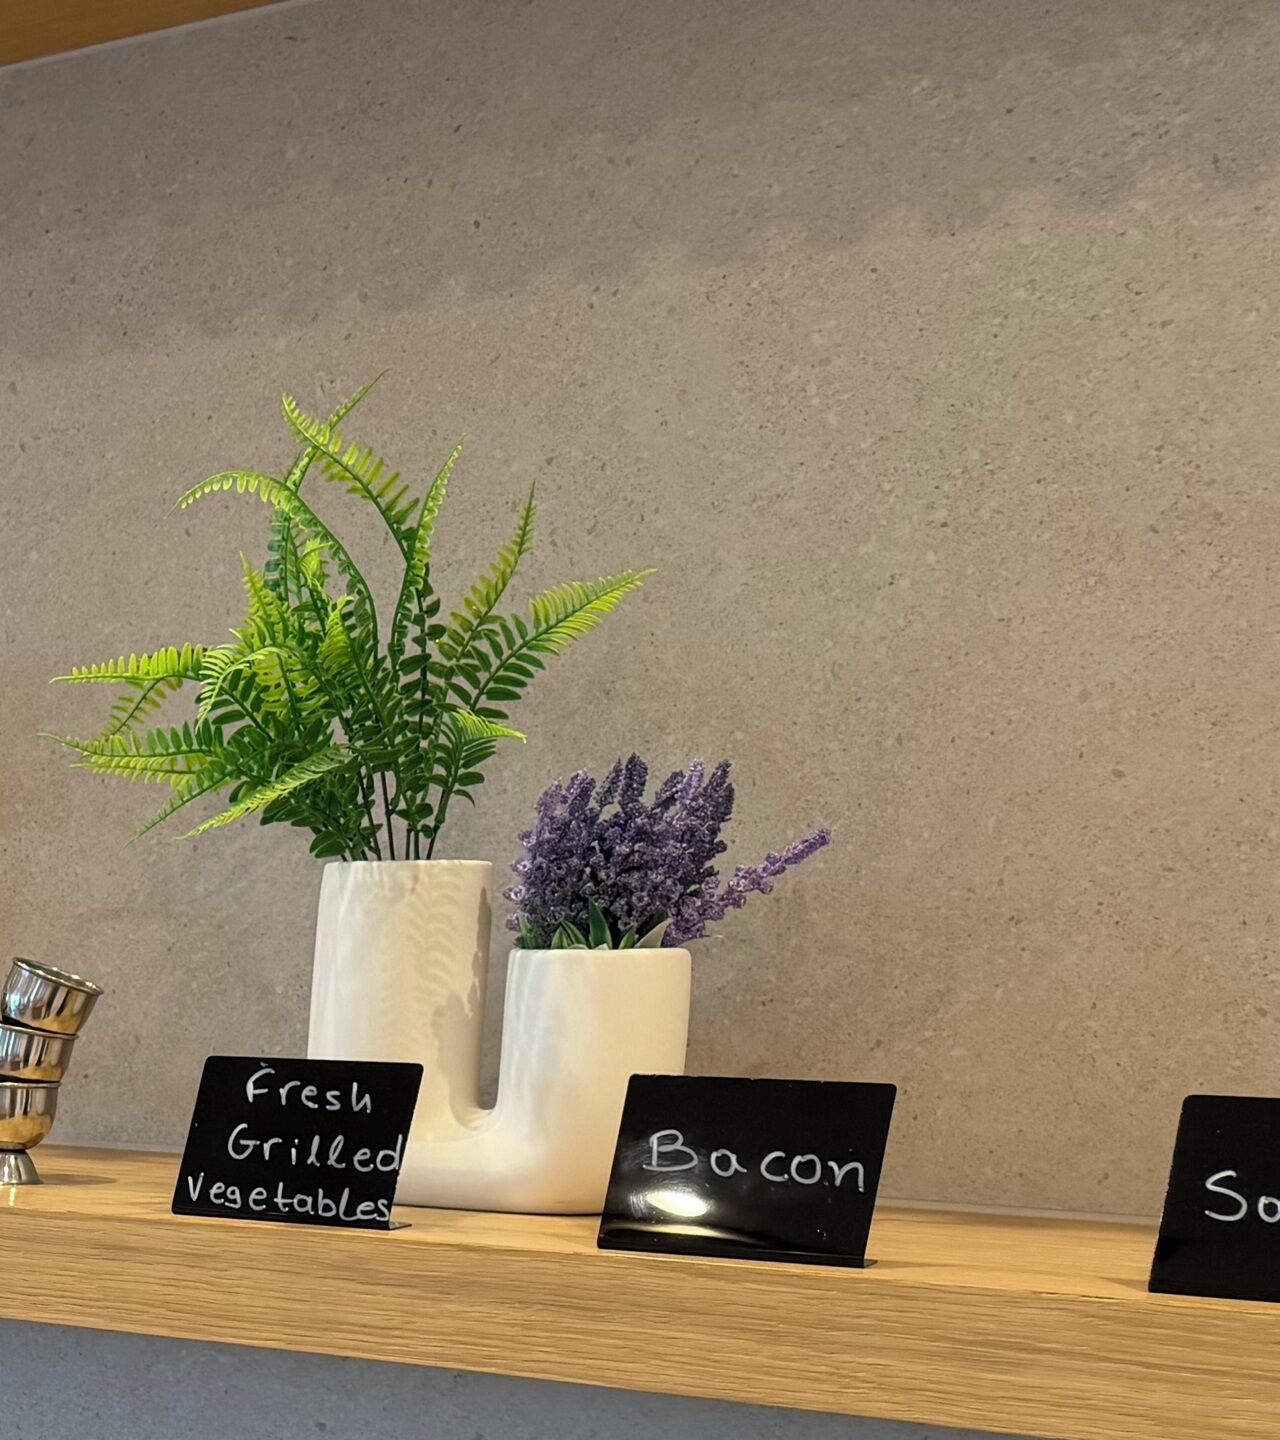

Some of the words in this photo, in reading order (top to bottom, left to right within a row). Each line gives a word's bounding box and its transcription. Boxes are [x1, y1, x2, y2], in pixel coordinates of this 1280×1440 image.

[245, 1062, 372, 1114] Fresh
[227, 1123, 404, 1173] Grilled
[642, 1128, 866, 1193] Bacon
[187, 1171, 391, 1221] Vegetables
